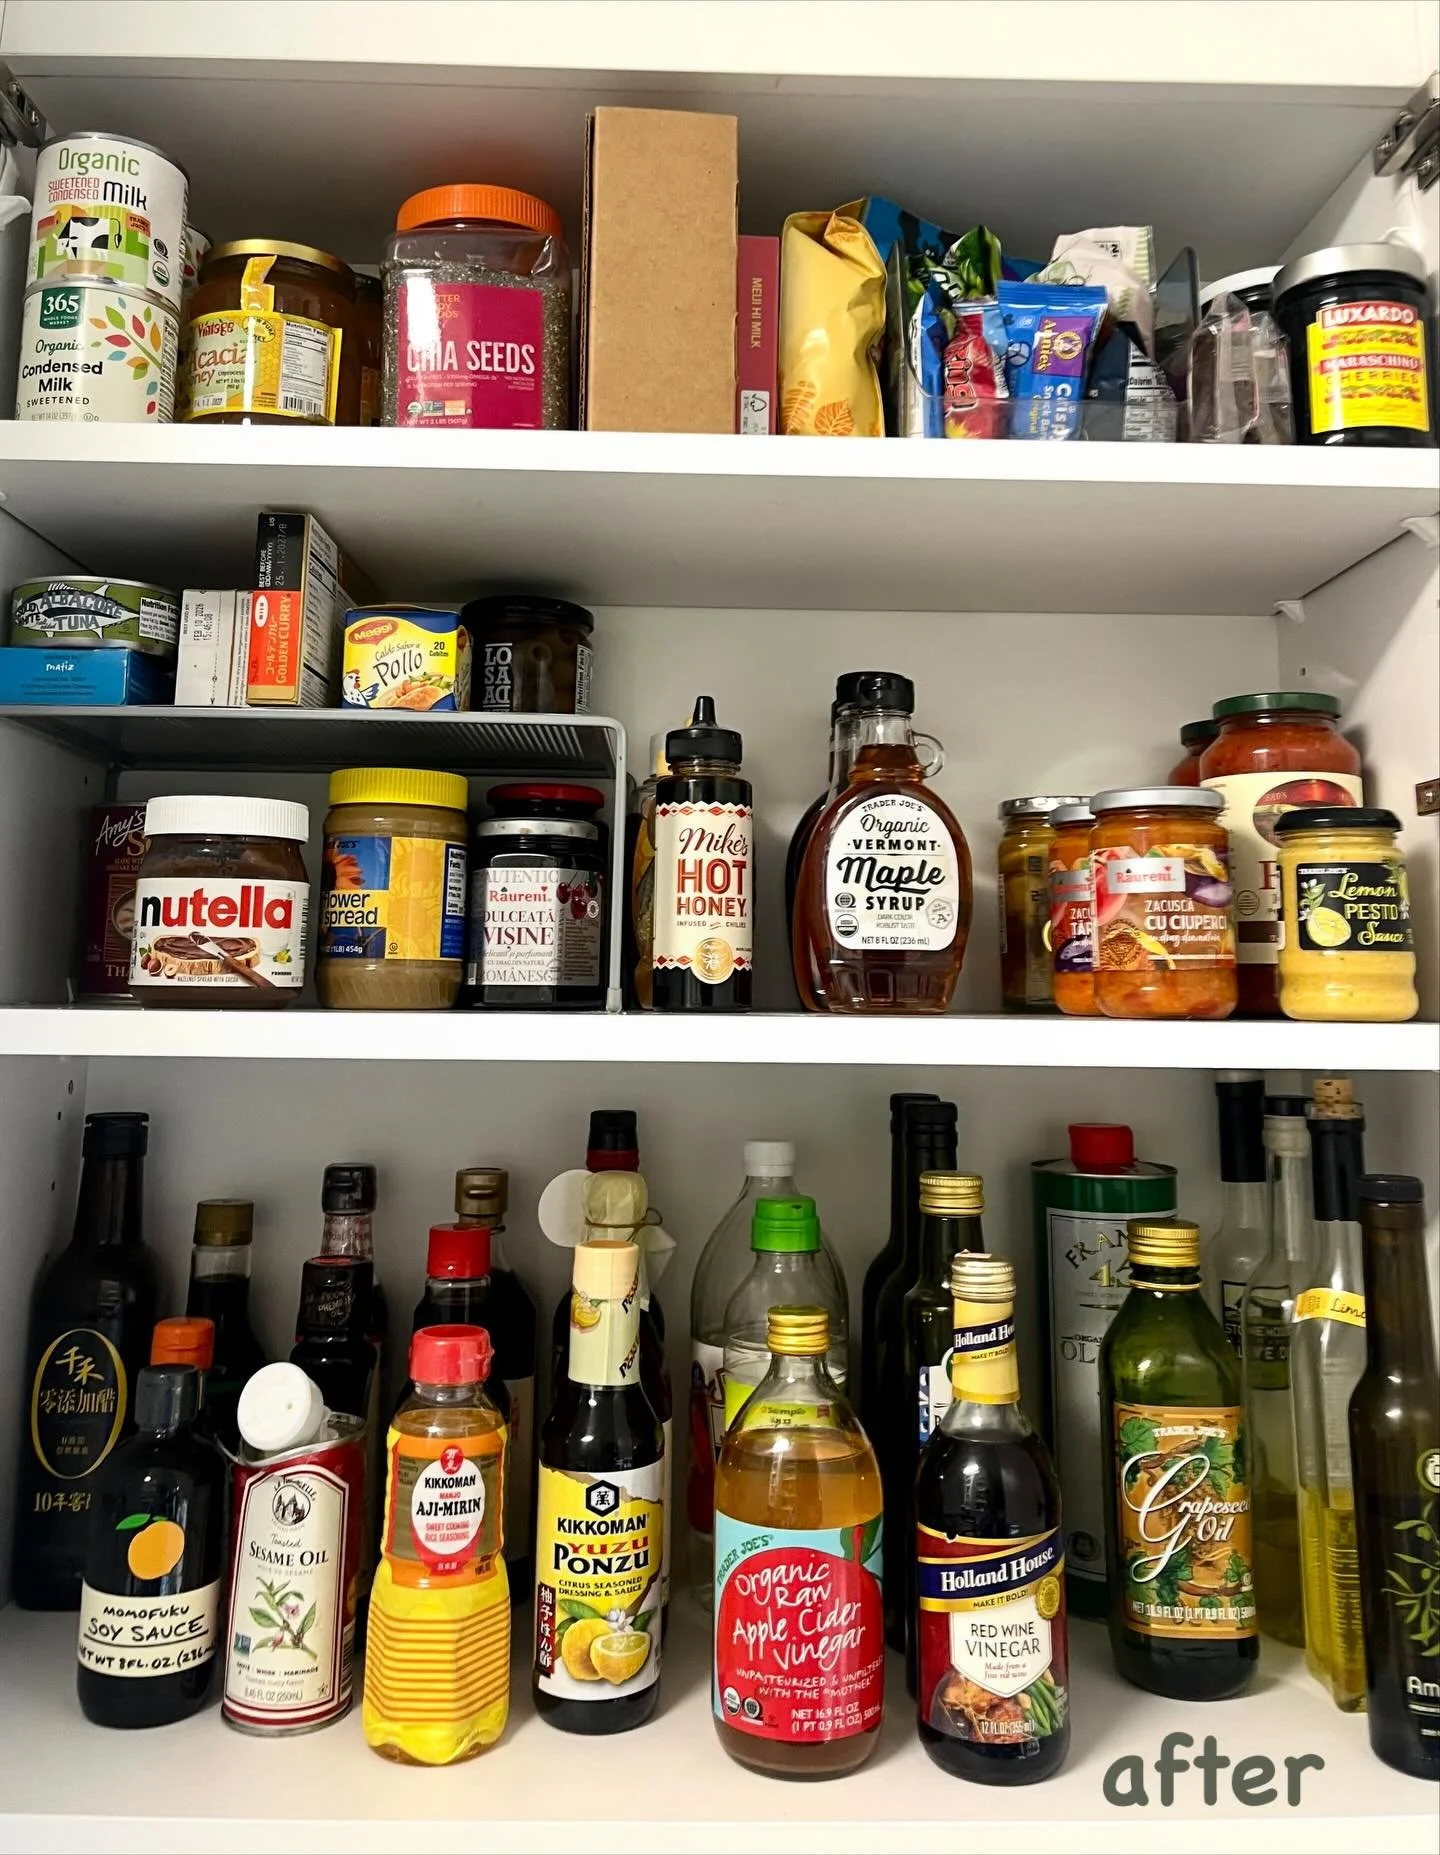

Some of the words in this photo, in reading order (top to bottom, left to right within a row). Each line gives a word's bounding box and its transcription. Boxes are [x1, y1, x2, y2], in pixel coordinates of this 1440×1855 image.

[59, 147, 140, 176] Organic
[49, 177, 100, 192] SWEETENED
[49, 188, 99, 202] CONDENSED
[44, 293, 80, 315] 365
[751, 308, 762, 319] HI
[1325, 306, 1415, 326] LUXARDO
[751, 320, 762, 348] MILK
[35, 339, 84, 356] Organic
[1035, 319, 1057, 372] Annie's
[407, 341, 458, 372] CHIA
[466, 341, 535, 375] SEEDS
[1325, 355, 1418, 372] MARASCHINO
[22, 359, 103, 379] Condensed
[1327, 371, 1420, 384] CHERRIES
[38, 378, 73, 393] Milk
[27, 397, 90, 408] SWEETENED
[259, 549, 267, 573] BEFORE
[40, 592, 122, 618] ALBACORE
[141, 598, 168, 611] Nutrition
[54, 615, 100, 630] TUNA
[278, 596, 292, 640] CURRY
[353, 623, 393, 641] Maggi
[375, 645, 396, 661] Caldo
[434, 641, 445, 651] 20
[275, 641, 289, 684] GOLDEN
[484, 647, 512, 666] LO
[46, 661, 75, 672] matiz
[373, 650, 423, 687] Pollo
[484, 667, 512, 685] SA
[576, 665, 586, 706] Nutrition
[861, 800, 897, 812] TRADER
[899, 799, 925, 812] JOE'S
[96, 810, 146, 856] Amy's
[860, 813, 930, 838] Organic
[679, 823, 748, 856] Mike's
[852, 839, 938, 851] VERMONT
[487, 870, 559, 883] AUTENTIC
[676, 858, 747, 895] HOT
[836, 856, 946, 895] Maple
[1328, 873, 1398, 901] Lemon
[140, 885, 293, 929] nutella
[866, 896, 926, 910] SYRUP
[1344, 903, 1400, 920] PESTO
[325, 907, 378, 925] spread
[1144, 916, 1167, 930] CU
[1169, 915, 1227, 931] CIUPERCI
[862, 937, 875, 945] NET
[882, 937, 889, 945] FL
[890, 937, 899, 945] OZ
[1357, 921, 1406, 946] Sauce
[345, 945, 363, 954] 454g
[954, 1328, 996, 1348] Holland
[424, 1475, 476, 1489] KIKKOMAN
[416, 1497, 481, 1516] AJI-MIRIN
[426, 1522, 445, 1531] SWEET
[557, 1514, 646, 1535] KIKKOMAN
[1196, 1516, 1234, 1542] Oil
[271, 1533, 303, 1547] Toasted
[425, 1532, 438, 1542] RICE
[567, 1536, 649, 1555] YUZU
[249, 1540, 295, 1566] SESAME
[300, 1550, 329, 1566] OIL
[554, 1543, 649, 1574] PONZU
[717, 1549, 738, 1586] TRADER
[740, 1534, 771, 1555] JOE'S
[941, 1563, 1008, 1591] Holland
[1010, 1547, 1053, 1580] House
[559, 1579, 591, 1589] CITRUS
[594, 1577, 642, 1589] SEASONED
[736, 1554, 830, 1606] Organic
[558, 1588, 602, 1597] DRESSING
[615, 1585, 642, 1595] SAUCE
[775, 1582, 832, 1608] Raw
[973, 1598, 995, 1609] MAKE
[997, 1596, 1005, 1605] IT
[1131, 1600, 1144, 1614] NET
[1163, 1606, 1173, 1618] FL
[1174, 1606, 1184, 1619] OZ
[1218, 1606, 1228, 1620] FL
[103, 1605, 190, 1620] MOMOFUKU
[88, 1618, 123, 1641] SOY
[131, 1614, 206, 1642] SAUCE
[733, 1606, 788, 1661] Apple
[799, 1598, 862, 1636] Cider
[971, 1623, 997, 1638] RED
[1001, 1621, 1035, 1636] WINE
[773, 1625, 866, 1671] Vinegar
[965, 1638, 1041, 1658] VINEGAR
[95, 1653, 115, 1668] WT
[737, 1667, 826, 1687] UNPASTEURIZED
[759, 1687, 791, 1698] WITH
[794, 1688, 820, 1699] THE
[791, 1709, 814, 1719] NET
[816, 1707, 831, 1719] 16.9
[833, 1706, 845, 1718] FL
[846, 1702, 860, 1713] OZ
[803, 1721, 817, 1732] PT
[818, 1719, 834, 1731] 0.9
[835, 1718, 845, 1729] FL
[847, 1711, 863, 1726] OZ)
[981, 1720, 990, 1732] 12
[991, 1720, 998, 1733] FL
